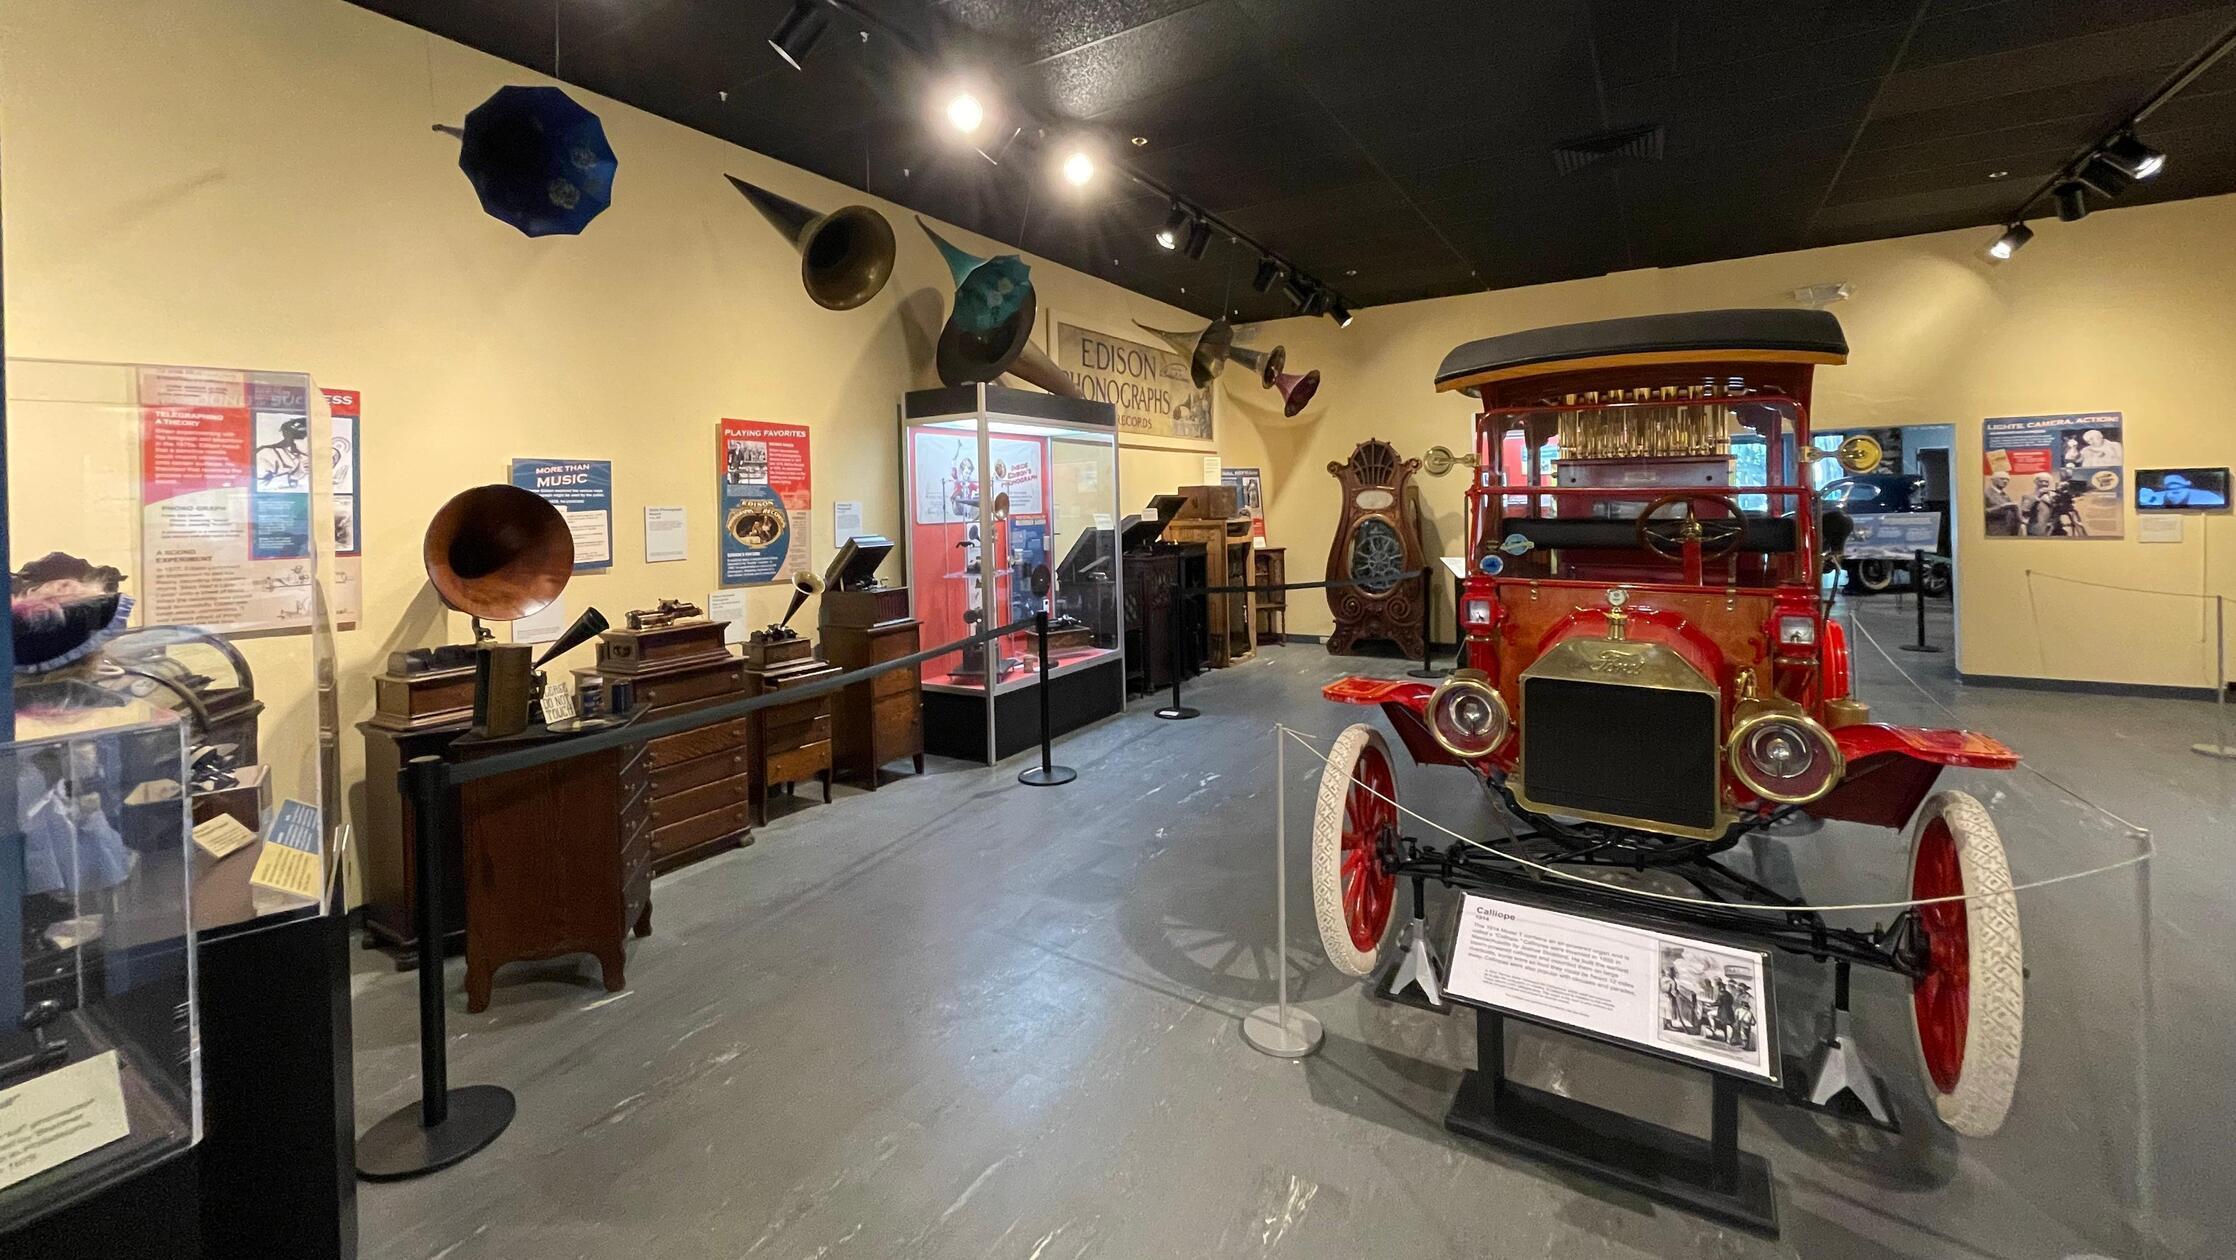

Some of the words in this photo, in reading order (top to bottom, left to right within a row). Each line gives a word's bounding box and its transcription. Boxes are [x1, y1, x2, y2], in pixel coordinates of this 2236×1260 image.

[1081, 338, 1156, 382] EDISON
[162, 419, 200, 428] THEORY
[724, 429, 762, 437] PLAYING
[763, 430, 807, 438] FAVORITES
[535, 465, 563, 475] MORE
[564, 463, 590, 472] THAN
[536, 473, 588, 488] MUSIC
[1590, 649, 1646, 675] Ford
[543, 698, 554, 709] DO
[554, 693, 571, 707] NOT
[545, 704, 574, 720] TOUCH
[1476, 906, 1516, 921] Calliope
